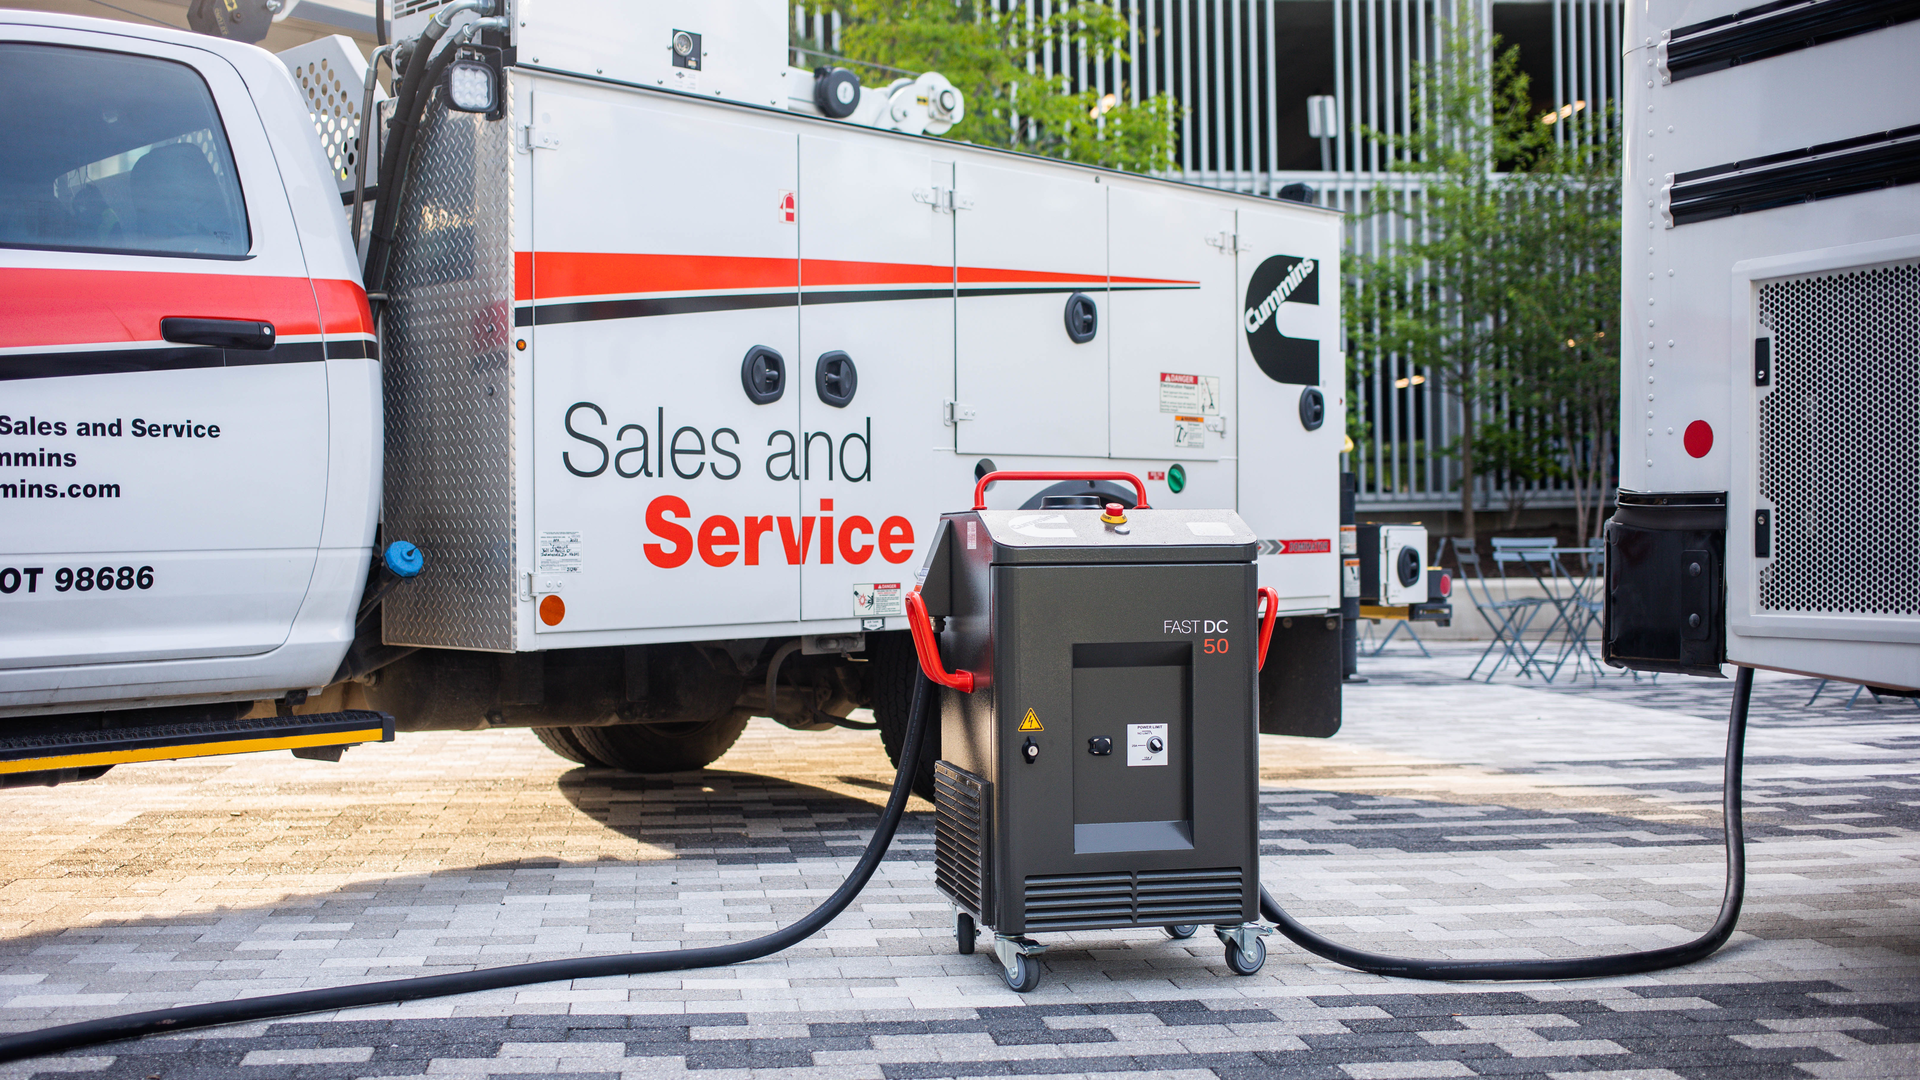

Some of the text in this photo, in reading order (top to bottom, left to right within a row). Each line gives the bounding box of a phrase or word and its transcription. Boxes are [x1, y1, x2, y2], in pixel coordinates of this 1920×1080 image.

[1244, 257, 1315, 334] Cummins
[1170, 374, 1195, 384] DANGER
[0, 415, 221, 438] Sales and Service
[562, 401, 871, 483] Sales and
[643, 494, 915, 569] Service
[1288, 541, 1329, 552] DOMINATOR
[54, 565, 155, 592] 98686
[1163, 619, 1229, 634] FAST DC
[1203, 638, 1229, 654] 50
